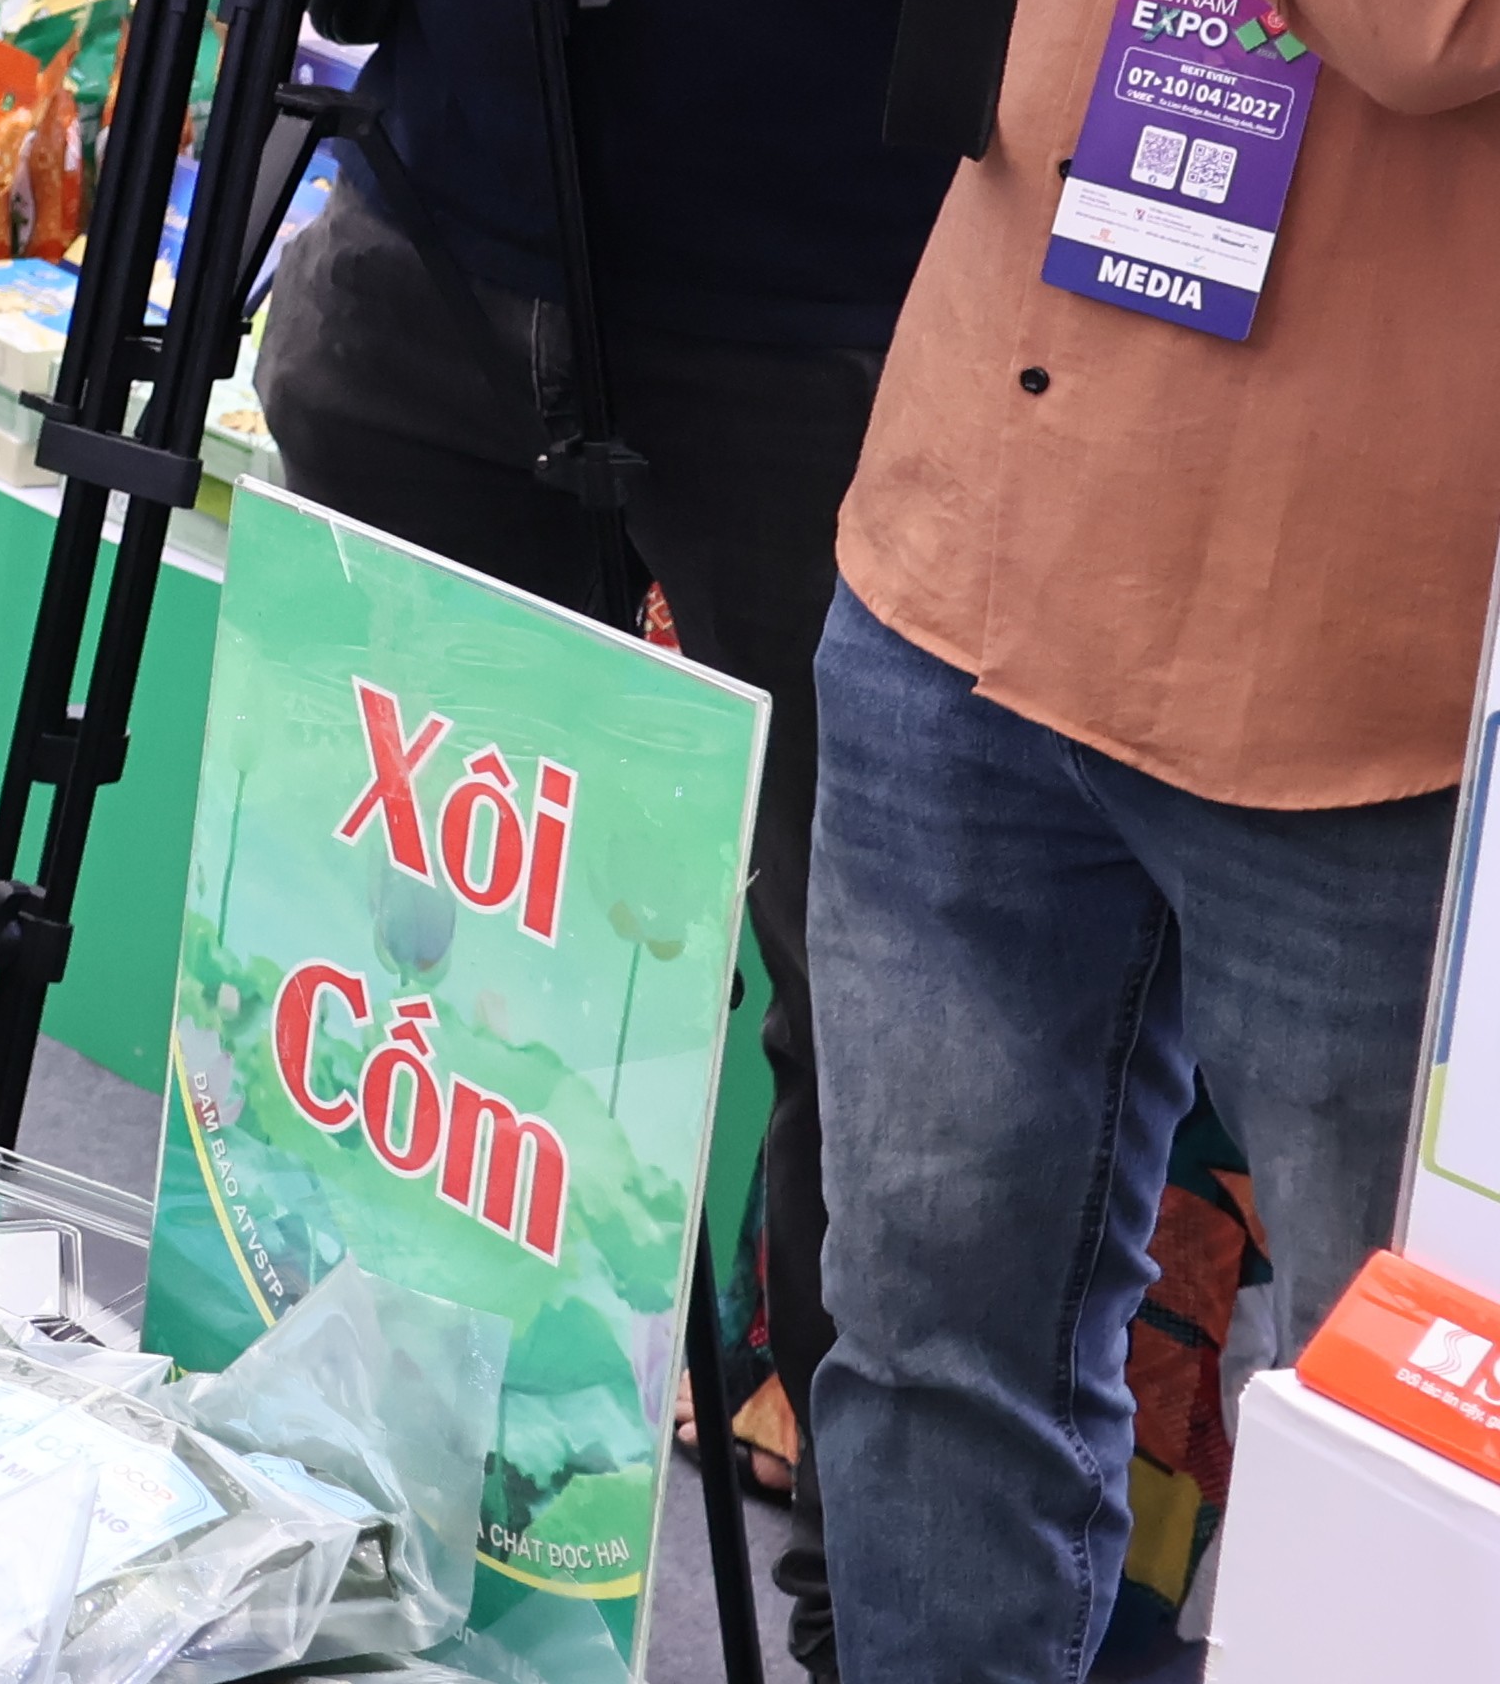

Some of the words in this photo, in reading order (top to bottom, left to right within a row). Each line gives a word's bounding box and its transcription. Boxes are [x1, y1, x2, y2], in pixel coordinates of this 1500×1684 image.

[1131, 0, 1229, 48] EXPO
[1096, 254, 1203, 311] MEDIA
[334, 674, 580, 947] Xôi
[273, 955, 574, 1268] Cốm
